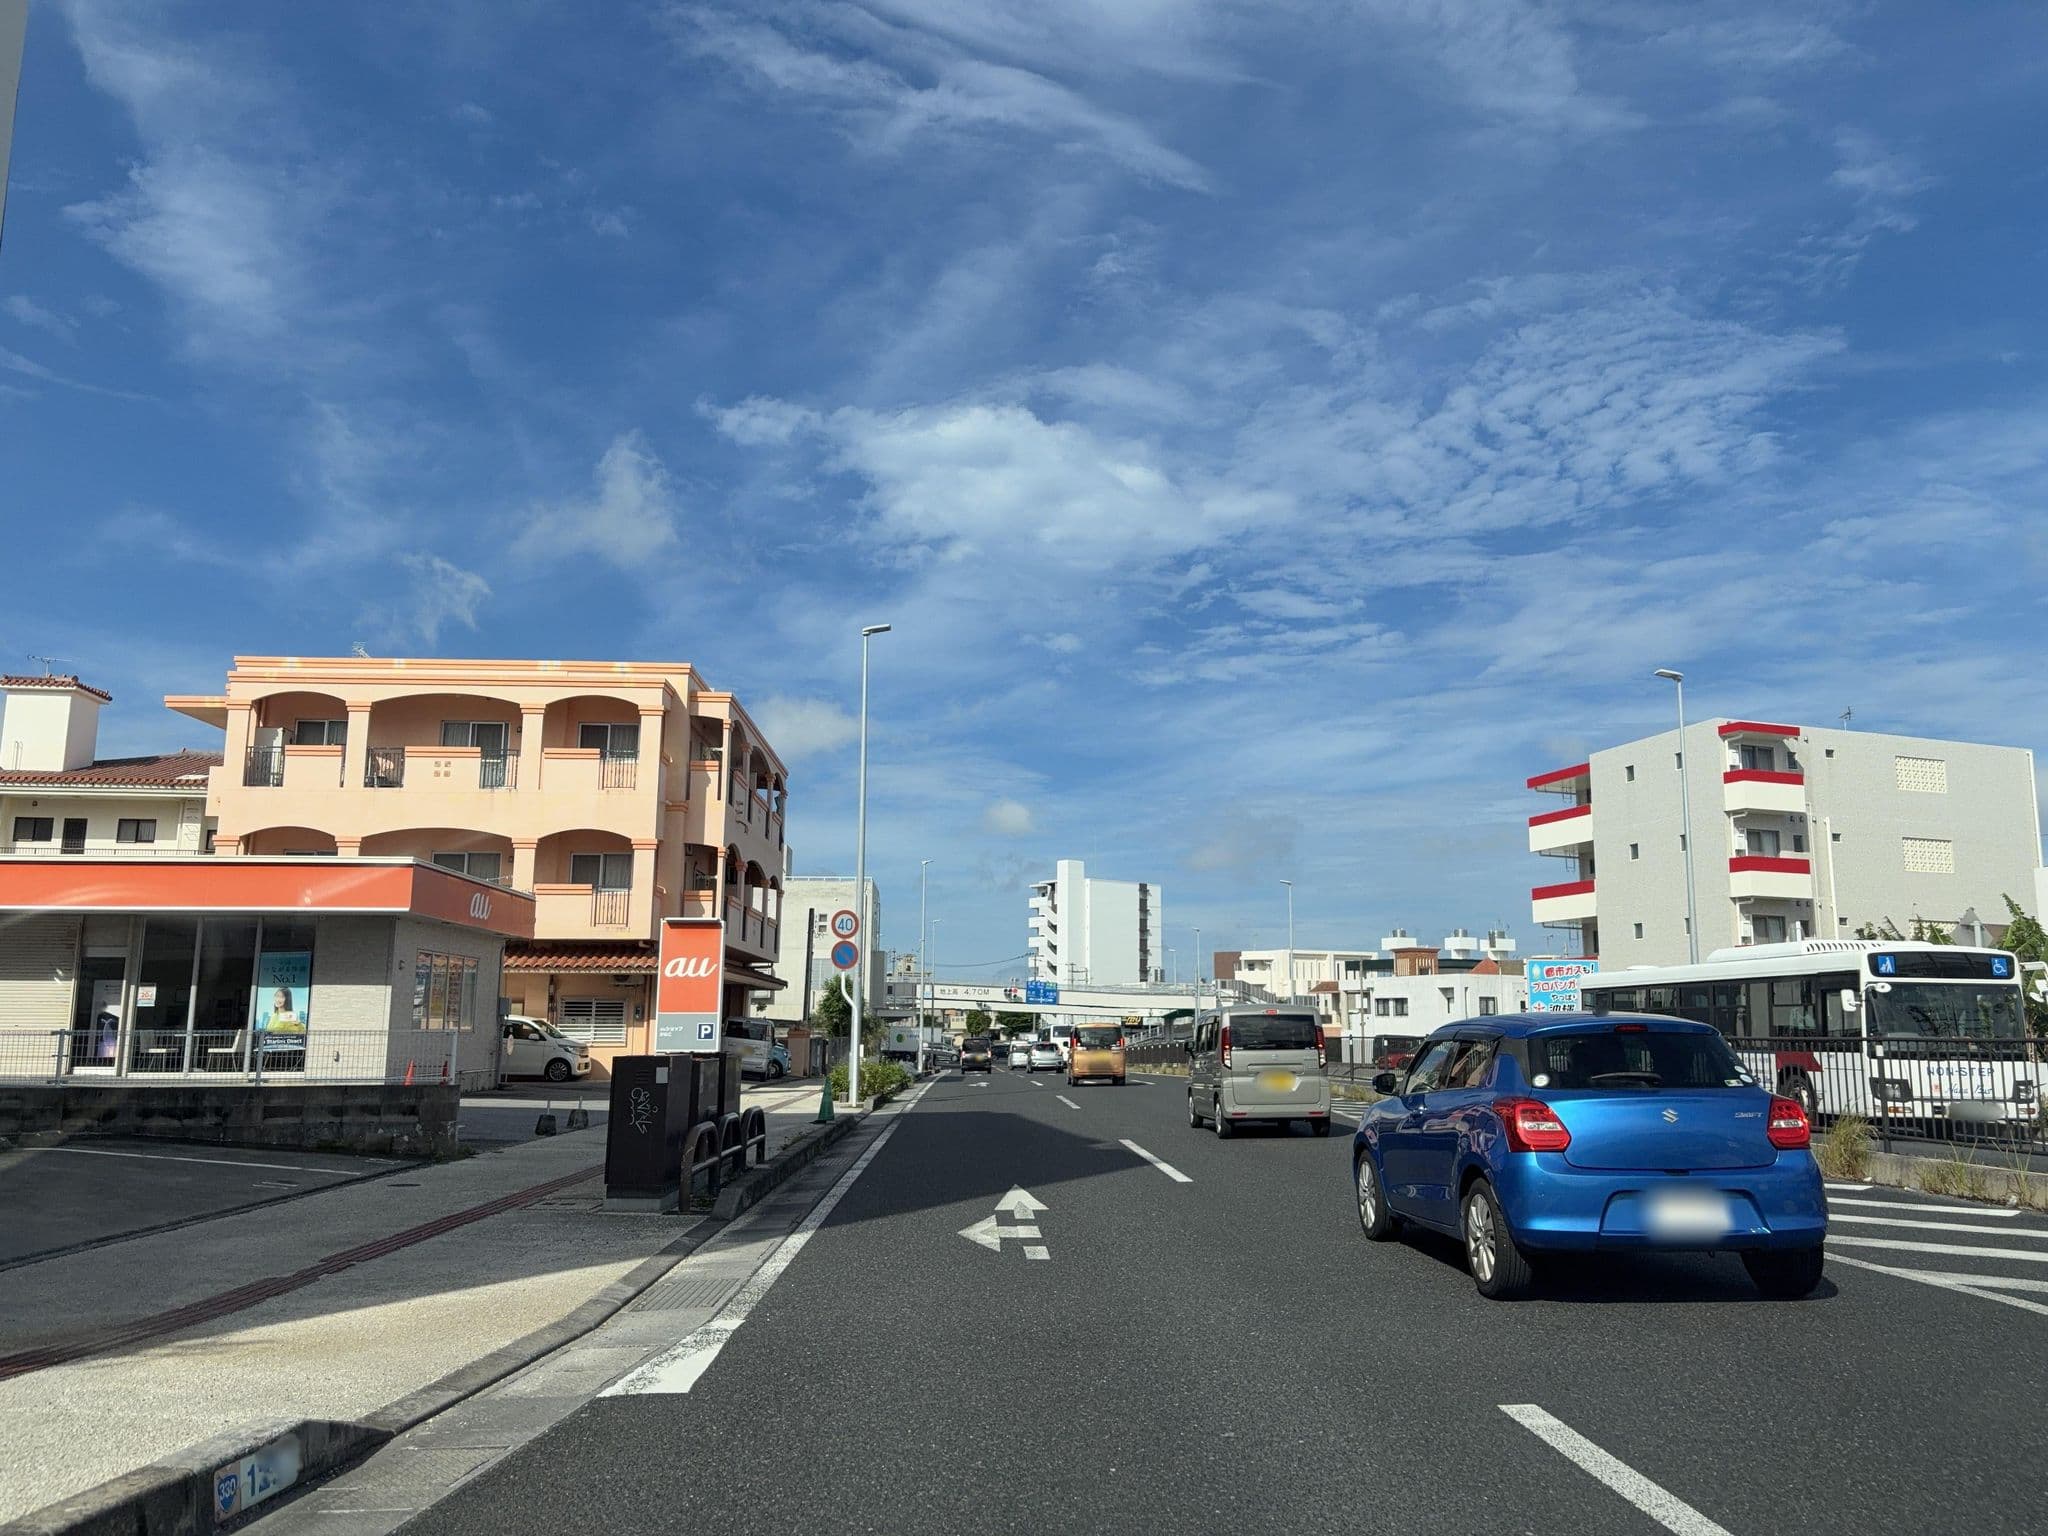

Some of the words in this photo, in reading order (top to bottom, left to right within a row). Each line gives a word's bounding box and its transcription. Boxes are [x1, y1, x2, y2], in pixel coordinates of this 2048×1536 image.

[470, 892, 493, 920] au
[837, 917, 853, 931] 40
[664, 956, 718, 978] au
[963, 988, 990, 996] 4.70M
[219, 1477, 237, 1499] 330
